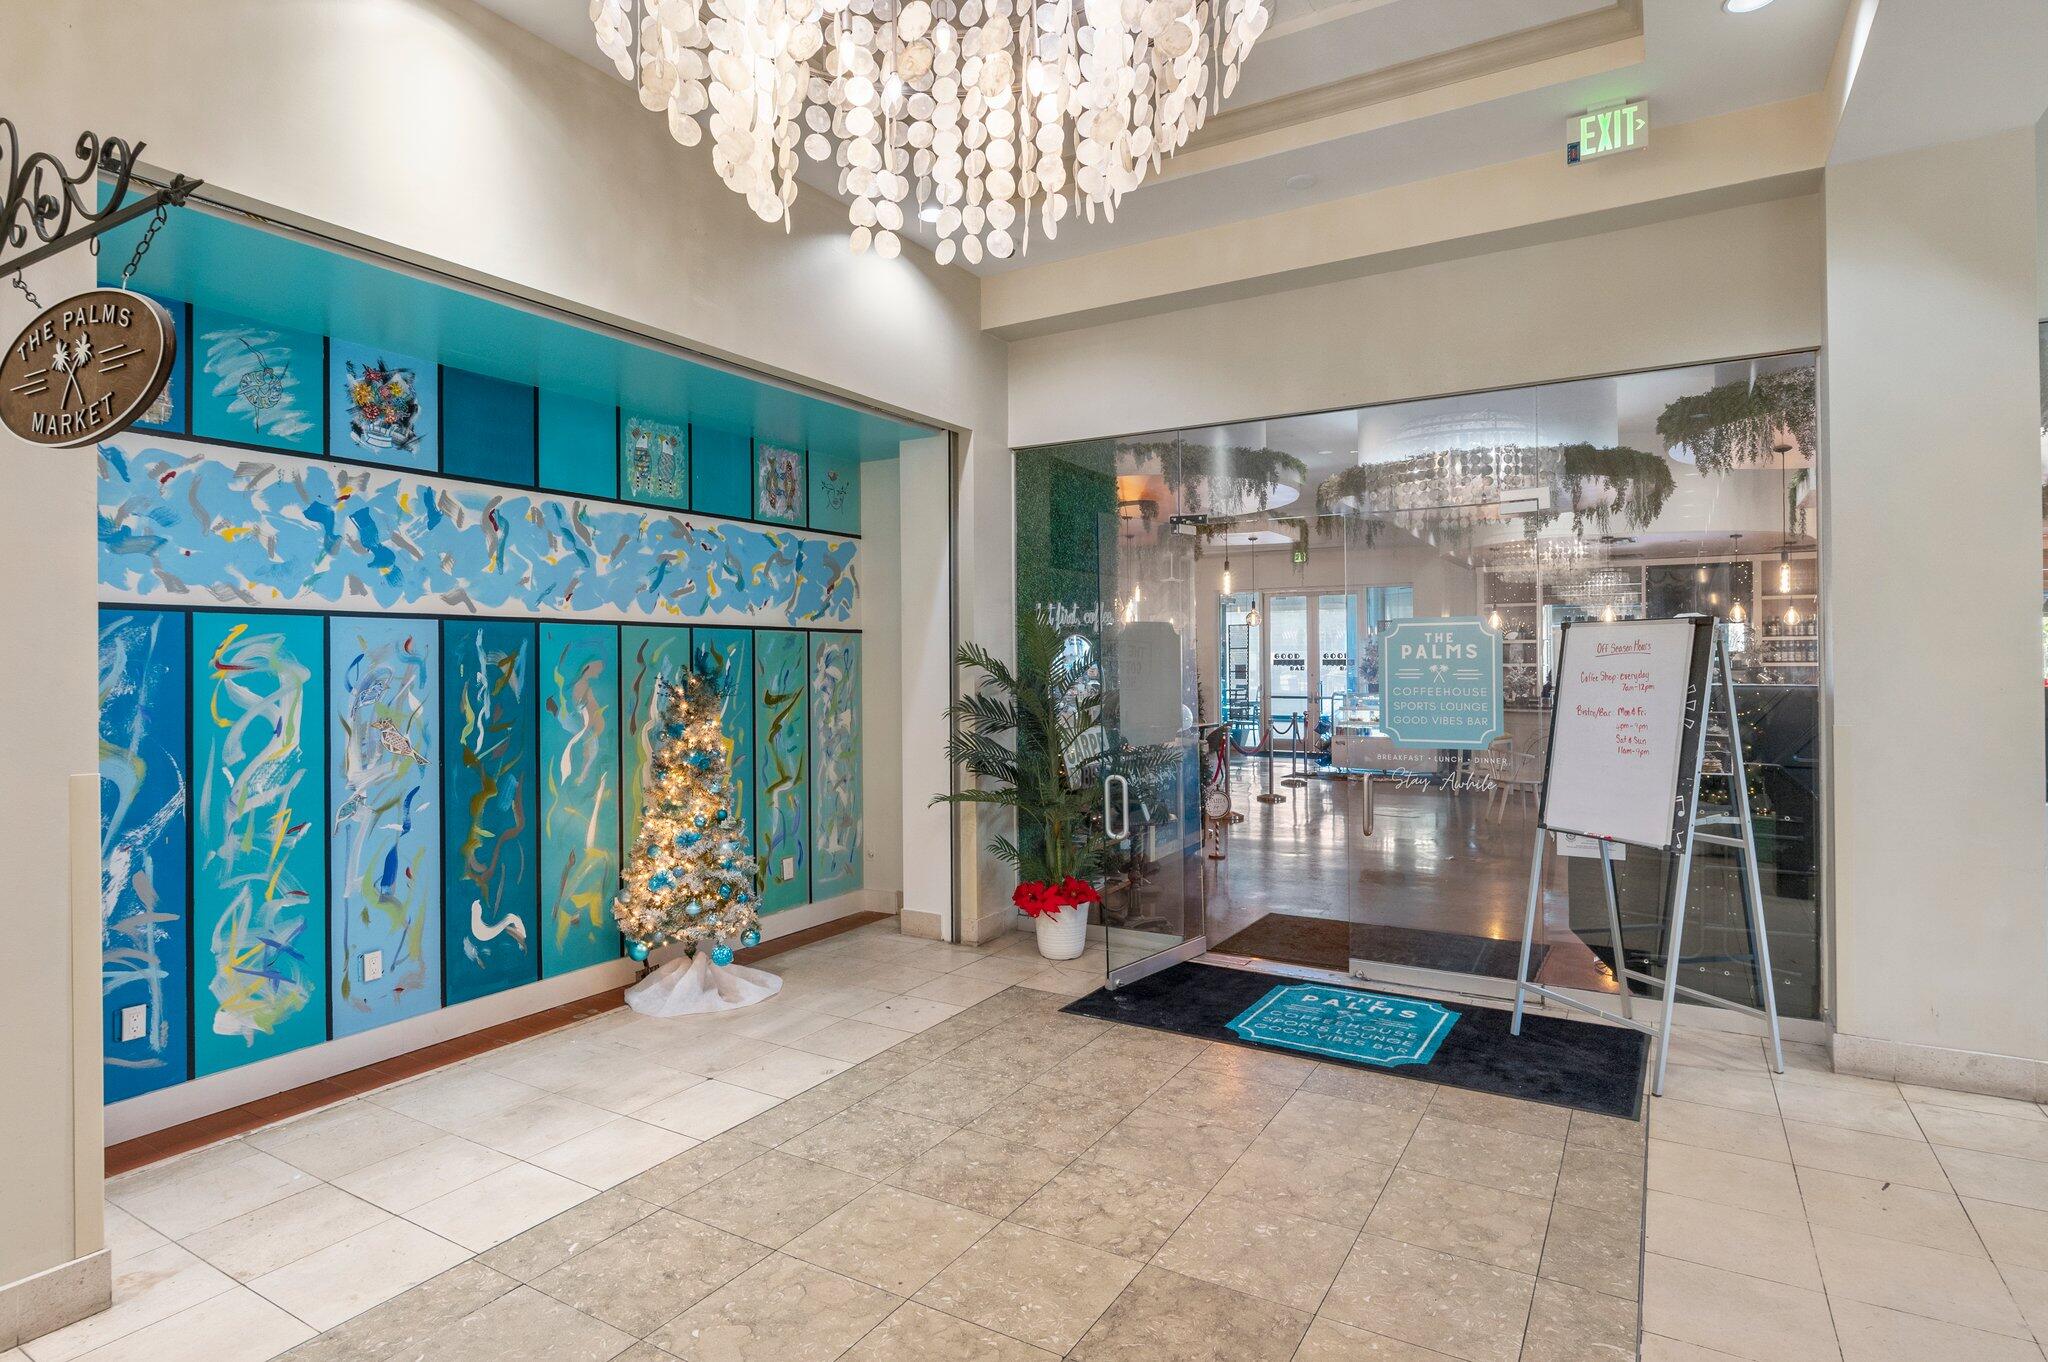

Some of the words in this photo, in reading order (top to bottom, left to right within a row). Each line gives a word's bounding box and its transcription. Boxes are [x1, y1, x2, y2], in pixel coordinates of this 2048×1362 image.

[1580, 106, 1638, 156] EXIT
[17, 320, 54, 361] THE
[63, 304, 132, 331] PALMS
[31, 391, 114, 436] MARKET
[1424, 632, 1454, 643] THE
[1401, 644, 1478, 659] PALMS
[1393, 687, 1487, 697] COFFEEHOUSE
[1393, 701, 1436, 711] SPORTS
[1440, 702, 1488, 712] LOUNGE
[1393, 716, 1428, 725] GOOD
[1432, 716, 1463, 725] VIBES
[1467, 717, 1488, 726] BAR
[1377, 753, 1424, 761] BREAKFAST
[1434, 755, 1463, 763] LUNCH
[1474, 757, 1508, 765] DINNER
[1391, 766, 1431, 793] Stay
[1439, 771, 1498, 792] Awhile
[1301, 994, 1418, 1019] PALMS
[1344, 995, 1388, 1007] THE
[1262, 1016, 1330, 1033] SPORTS
[1335, 1028, 1414, 1047] LOUNGE
[1270, 1010, 1418, 1040] COFFEEHOUSE
[1254, 1022, 1309, 1036] GOOD
[1317, 1033, 1366, 1047] VIBES
[1373, 1043, 1408, 1054] BAR
